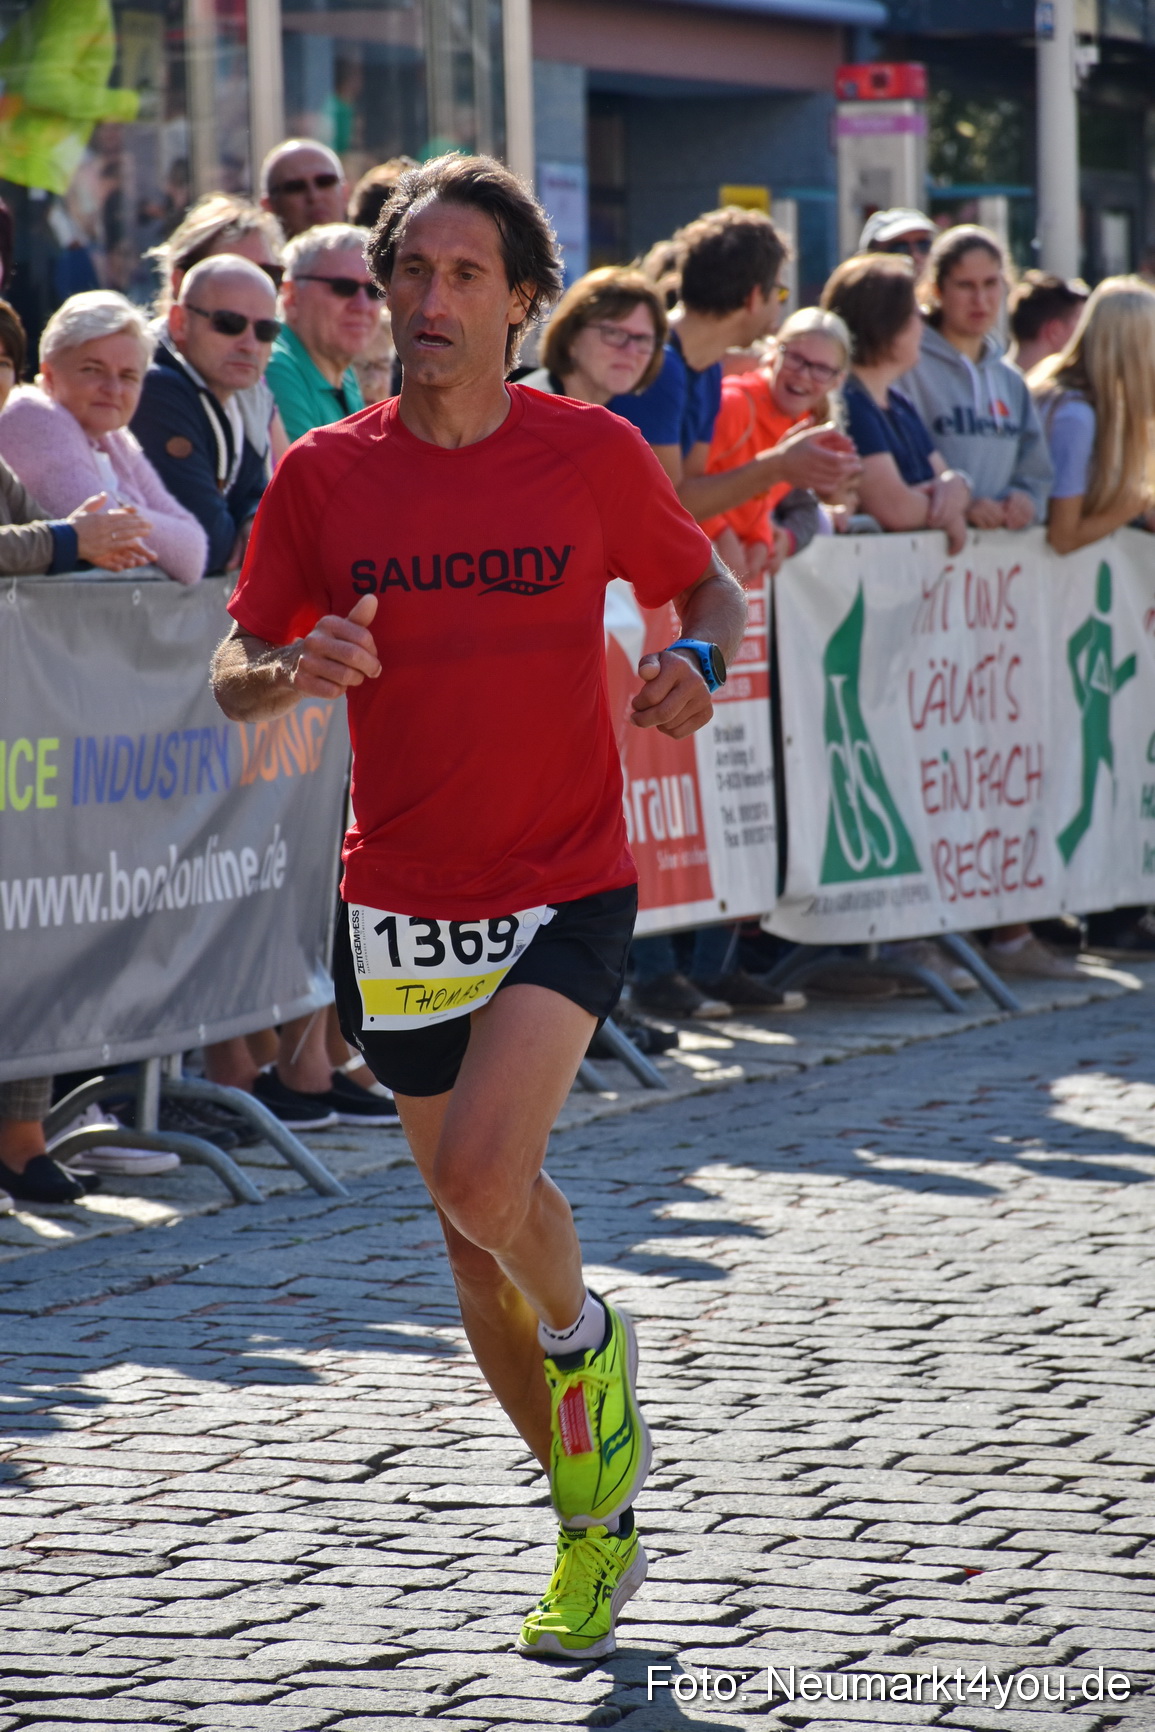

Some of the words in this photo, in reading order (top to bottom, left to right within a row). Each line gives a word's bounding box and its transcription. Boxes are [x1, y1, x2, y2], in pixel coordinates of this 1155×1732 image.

[964, 563, 1021, 630] UNS
[72, 724, 231, 806] INDUSTRY
[1, 823, 287, 930] www.bockonline.de
[374, 914, 519, 967] 1369
[396, 979, 485, 1014] THOMAS
